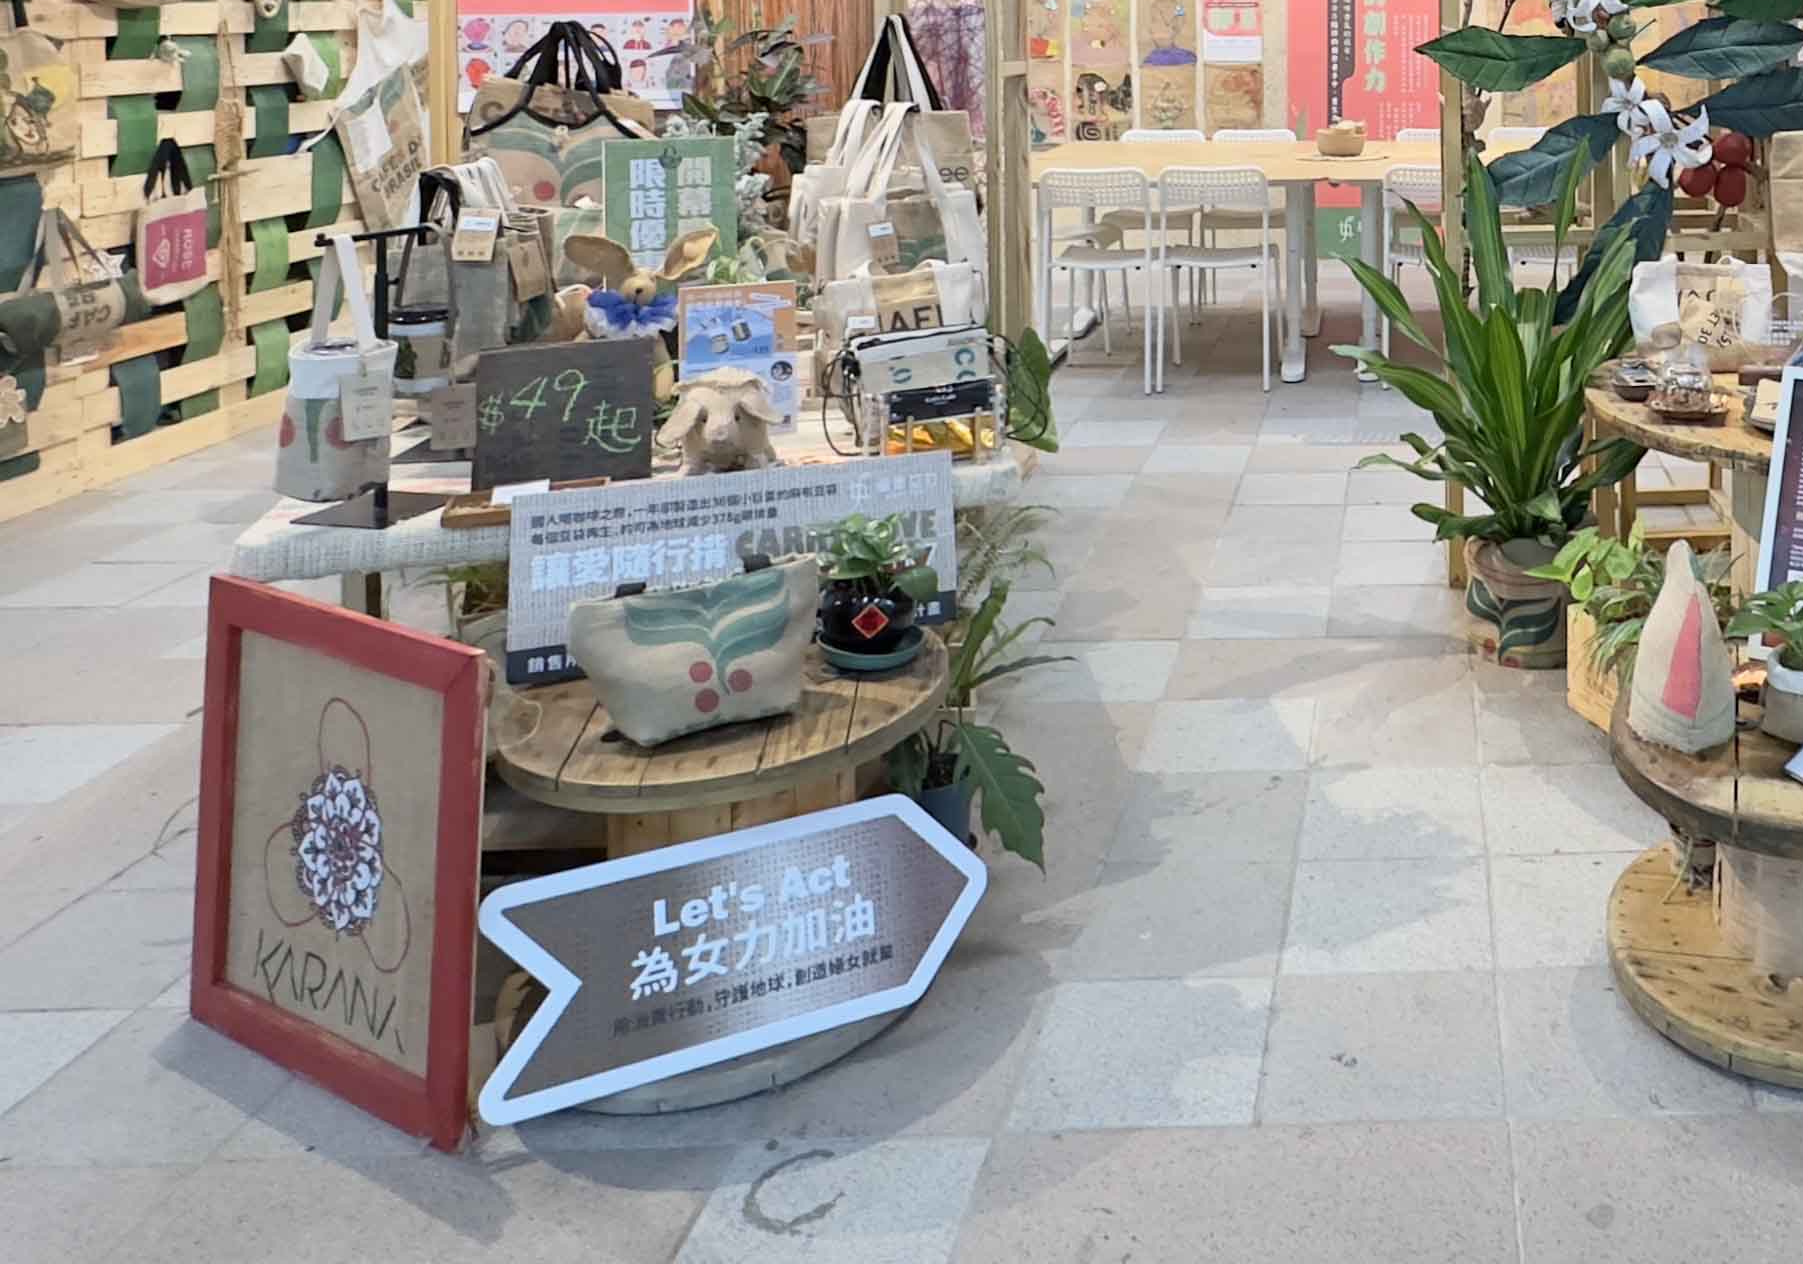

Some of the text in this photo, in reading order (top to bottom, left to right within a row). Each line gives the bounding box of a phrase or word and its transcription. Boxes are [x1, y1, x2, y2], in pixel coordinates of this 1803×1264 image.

[653, 854, 851, 937] Let's Act
[629, 892, 877, 1002] 為女力加油
